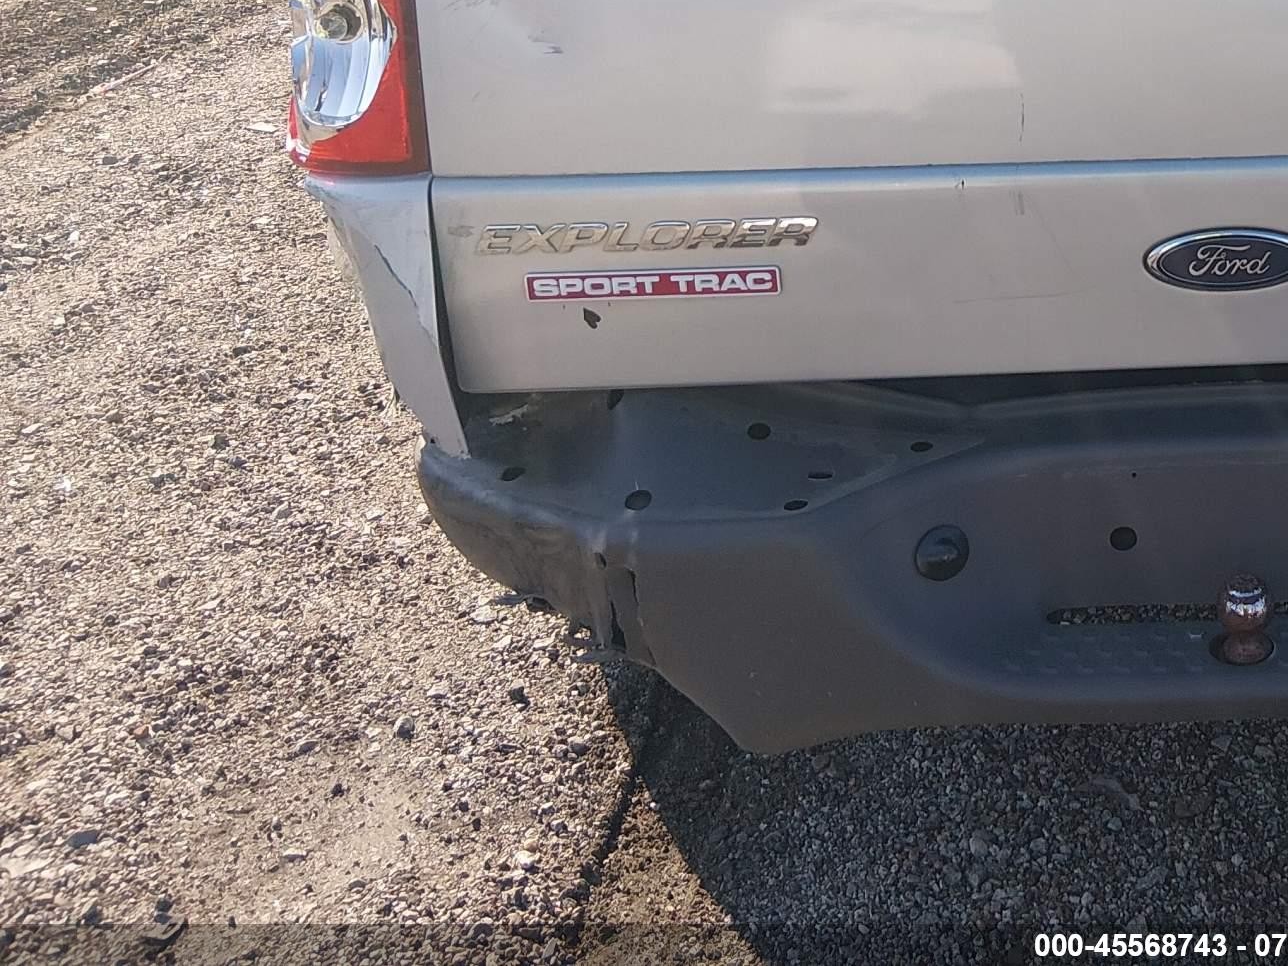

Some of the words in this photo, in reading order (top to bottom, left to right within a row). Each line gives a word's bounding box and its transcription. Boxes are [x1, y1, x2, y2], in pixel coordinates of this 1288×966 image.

[476, 215, 818, 255] EXPLORER
[1188, 244, 1271, 276] Ford
[533, 276, 659, 298] SPORT
[670, 272, 773, 294] TRAC
